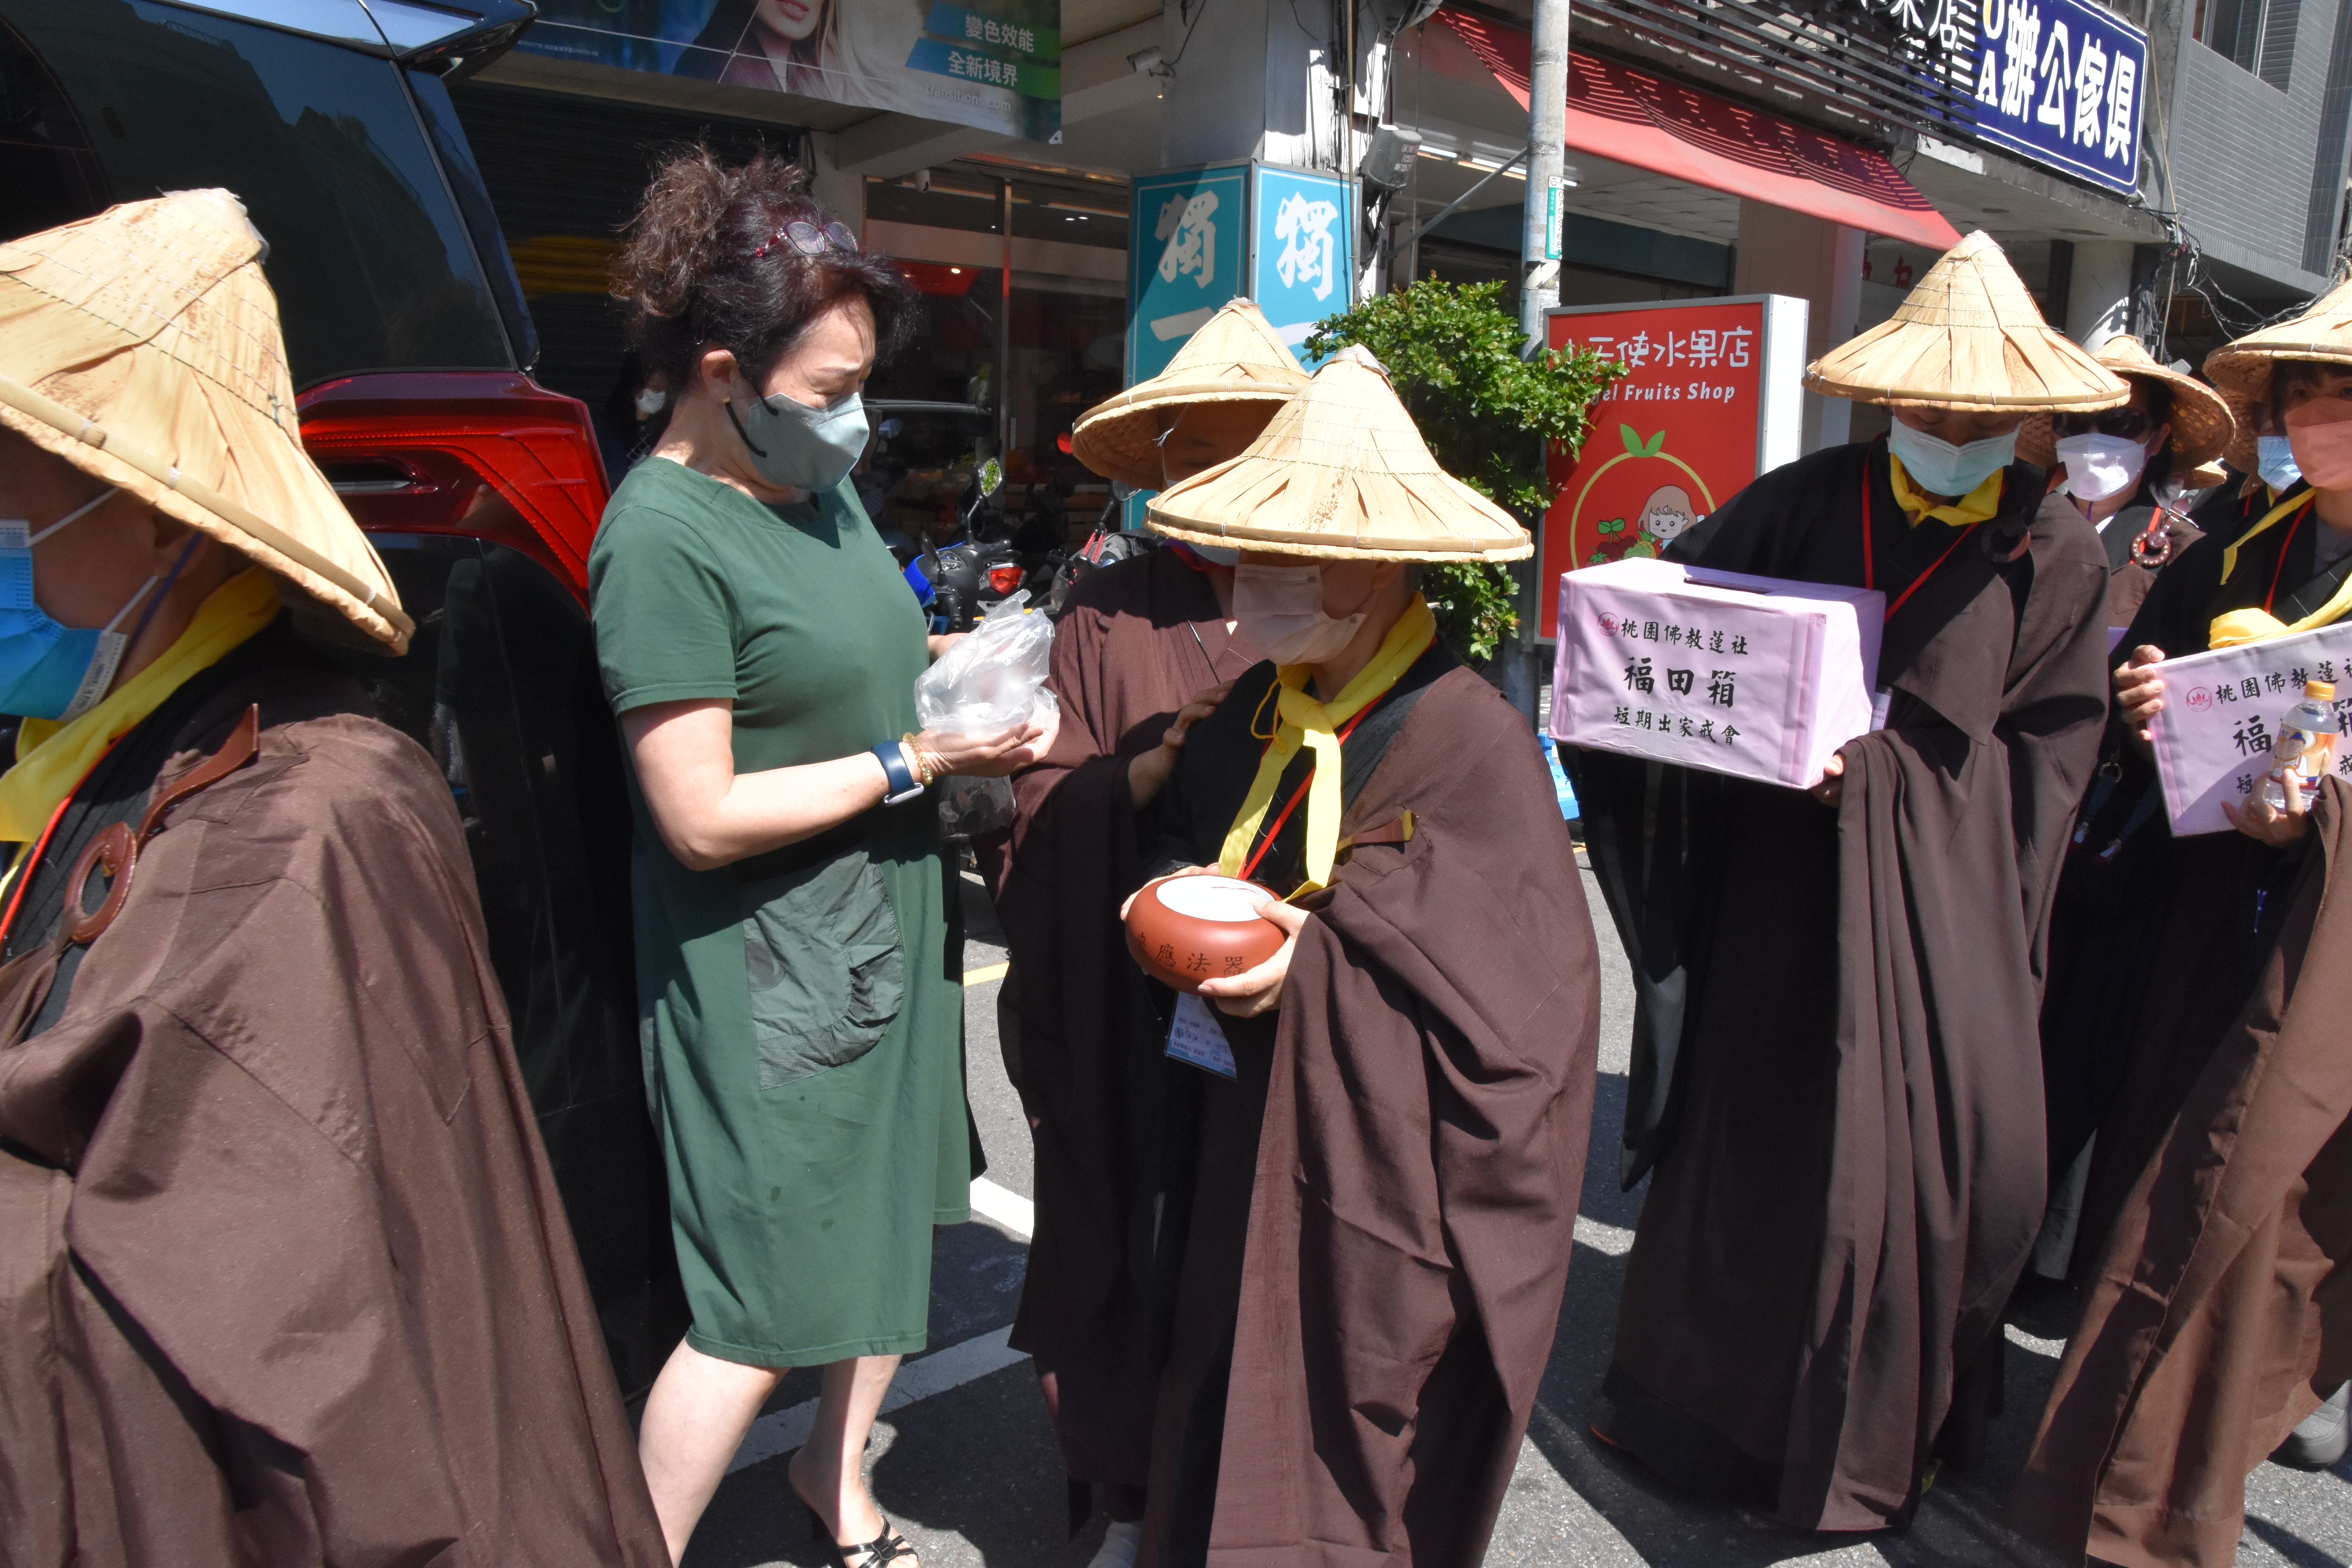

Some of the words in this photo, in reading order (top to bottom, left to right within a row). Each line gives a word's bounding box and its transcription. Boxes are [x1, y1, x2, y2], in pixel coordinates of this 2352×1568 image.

[965, 15, 1034, 53] 變色效能
[948, 51, 1018, 87] 全新境界
[925, 84, 1011, 112] transitions.com
[1272, 191, 1338, 377] 獨一
[1590, 383, 1618, 406] gel
[1624, 383, 1680, 401] Fruits
[1687, 382, 1735, 403] Shop
[1621, 618, 1748, 656] 桃園佛教蓮社
[1623, 657, 1737, 708] 福田箱
[1613, 706, 1741, 745] 短期出家戒會
